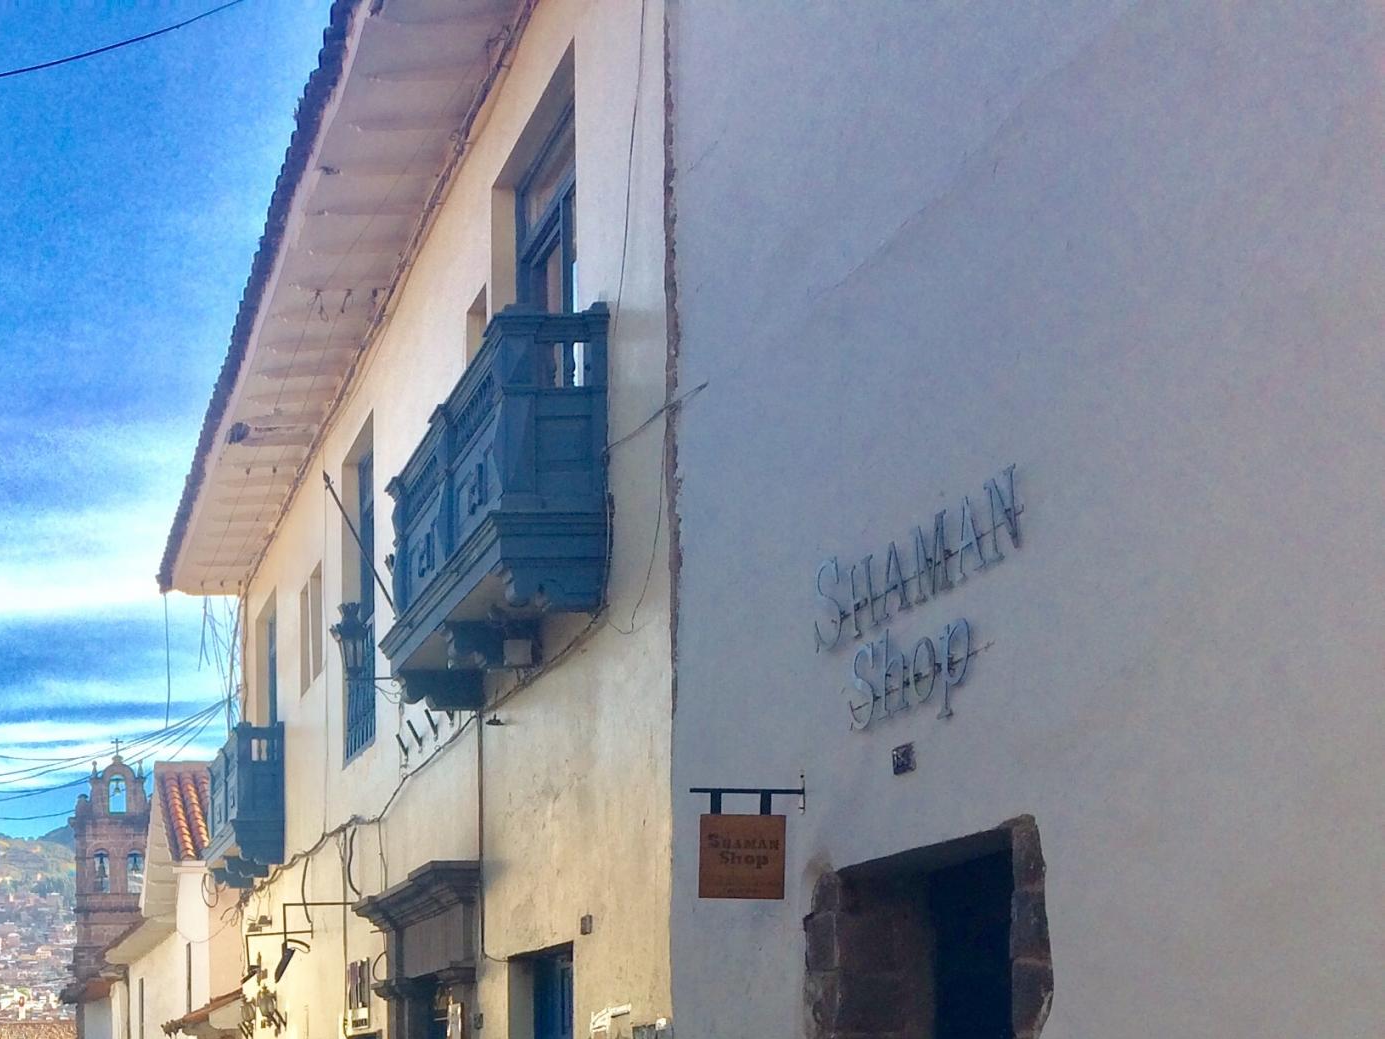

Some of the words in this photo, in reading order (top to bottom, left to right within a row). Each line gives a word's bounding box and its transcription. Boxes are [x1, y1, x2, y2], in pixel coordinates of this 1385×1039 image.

[815, 463, 1022, 654] SHAMAN
[848, 617, 971, 732] Shop
[707, 831, 780, 851] SHAMAN
[719, 850, 769, 870] Shop
